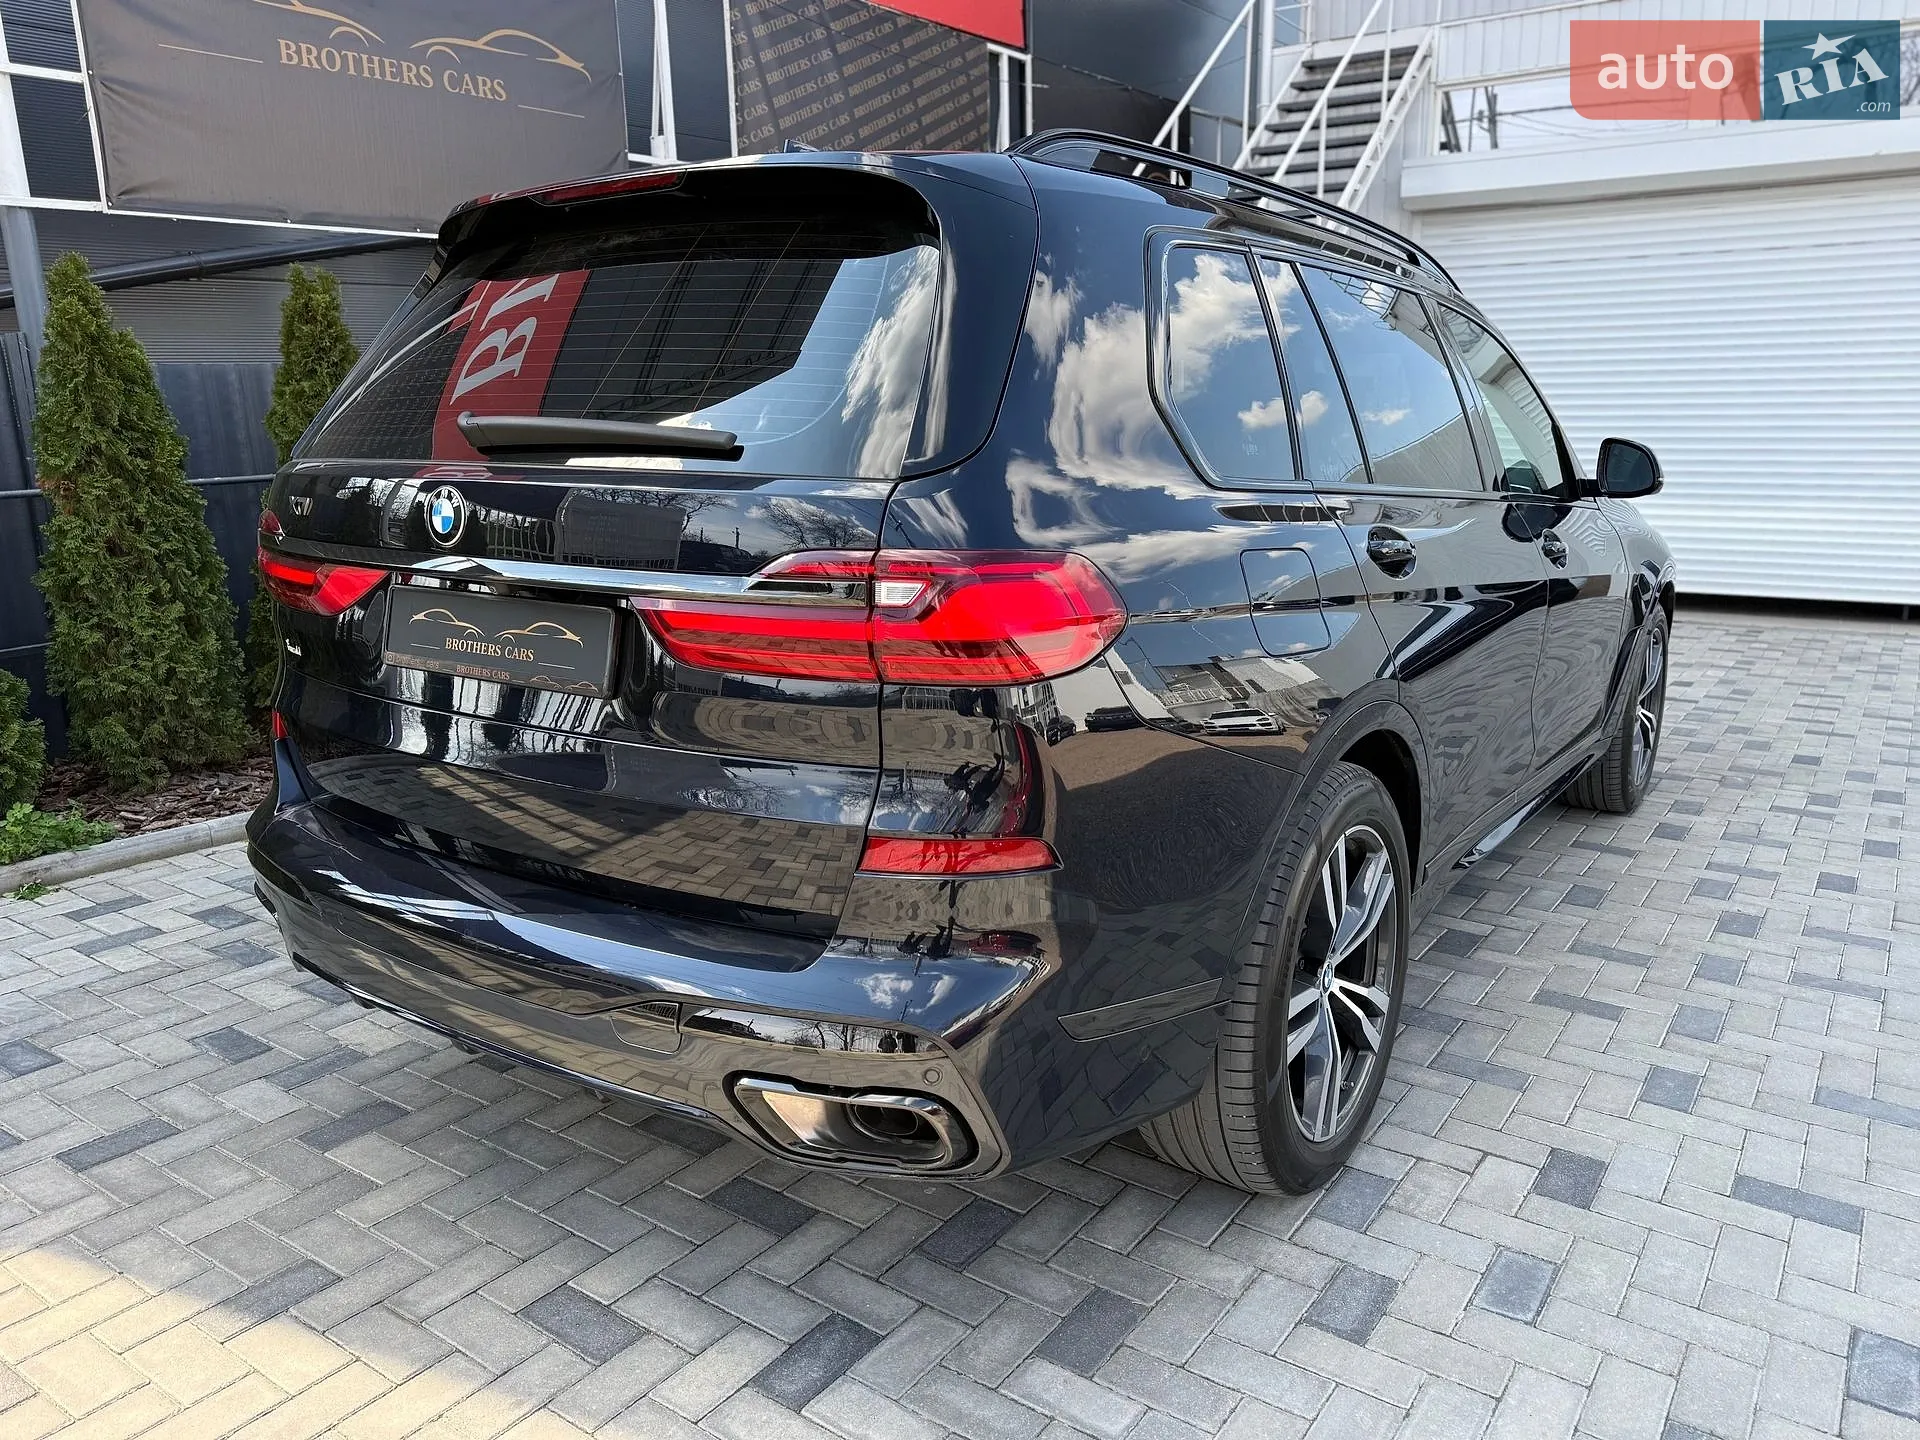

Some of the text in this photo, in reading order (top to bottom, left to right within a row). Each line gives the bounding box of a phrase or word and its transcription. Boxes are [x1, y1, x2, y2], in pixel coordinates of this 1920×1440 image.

[752, 13, 798, 38] BROTHERS
[798, 3, 820, 20] CARS
[760, 35, 805, 63] BROTHERS
[805, 27, 827, 44] CARS
[277, 38, 507, 102] BROTHERS CARS
[766, 57, 811, 85] BROTHERS
[811, 48, 833, 65] CARS
[744, 102, 769, 121] CARS
[772, 79, 817, 109] BROTHERS
[817, 70, 840, 88] CARS
[750, 123, 775, 142] CARS
[778, 100, 823, 130] BROTHERS
[823, 91, 845, 109] CARS
[829, 112, 850, 130] CARS
[445, 637, 534, 662] BROTHERS CARS
[456, 664, 511, 681] BROTHERS CARS
